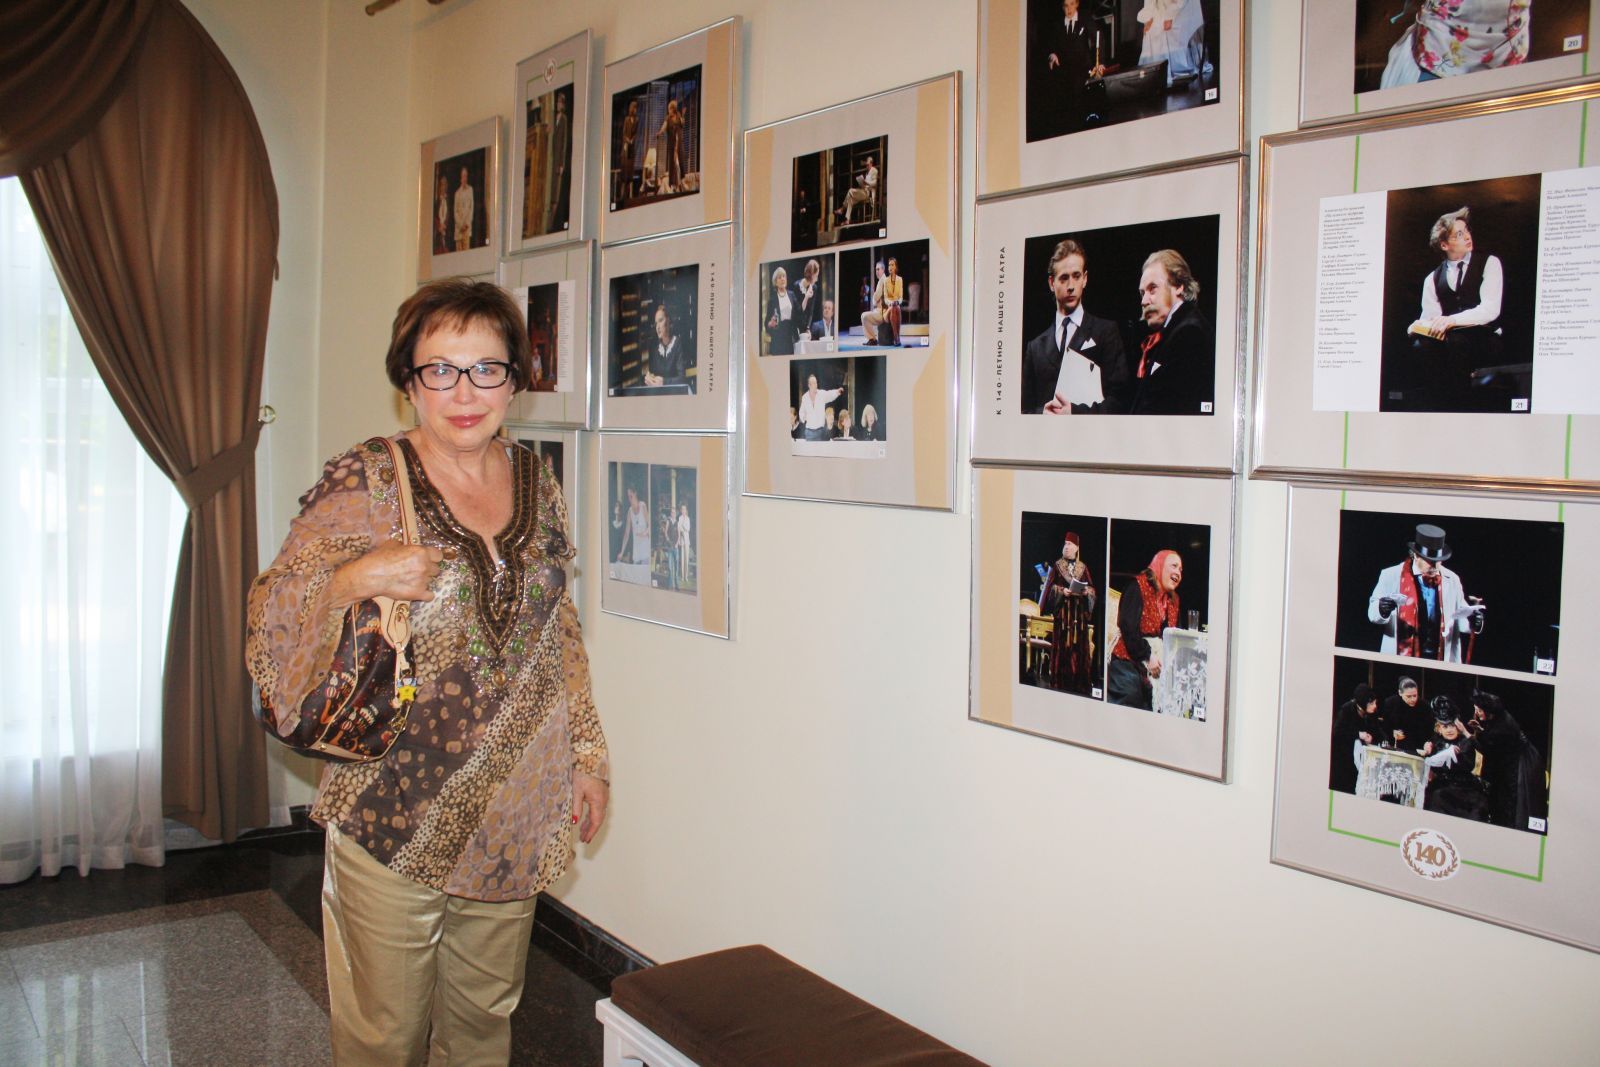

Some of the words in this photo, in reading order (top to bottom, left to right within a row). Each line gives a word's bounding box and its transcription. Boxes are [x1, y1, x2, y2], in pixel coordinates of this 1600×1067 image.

[1567, 39, 1579, 49] 20
[1515, 401, 1523, 409] 21
[1543, 663, 1552, 671] 22
[1415, 842, 1446, 867] 140
